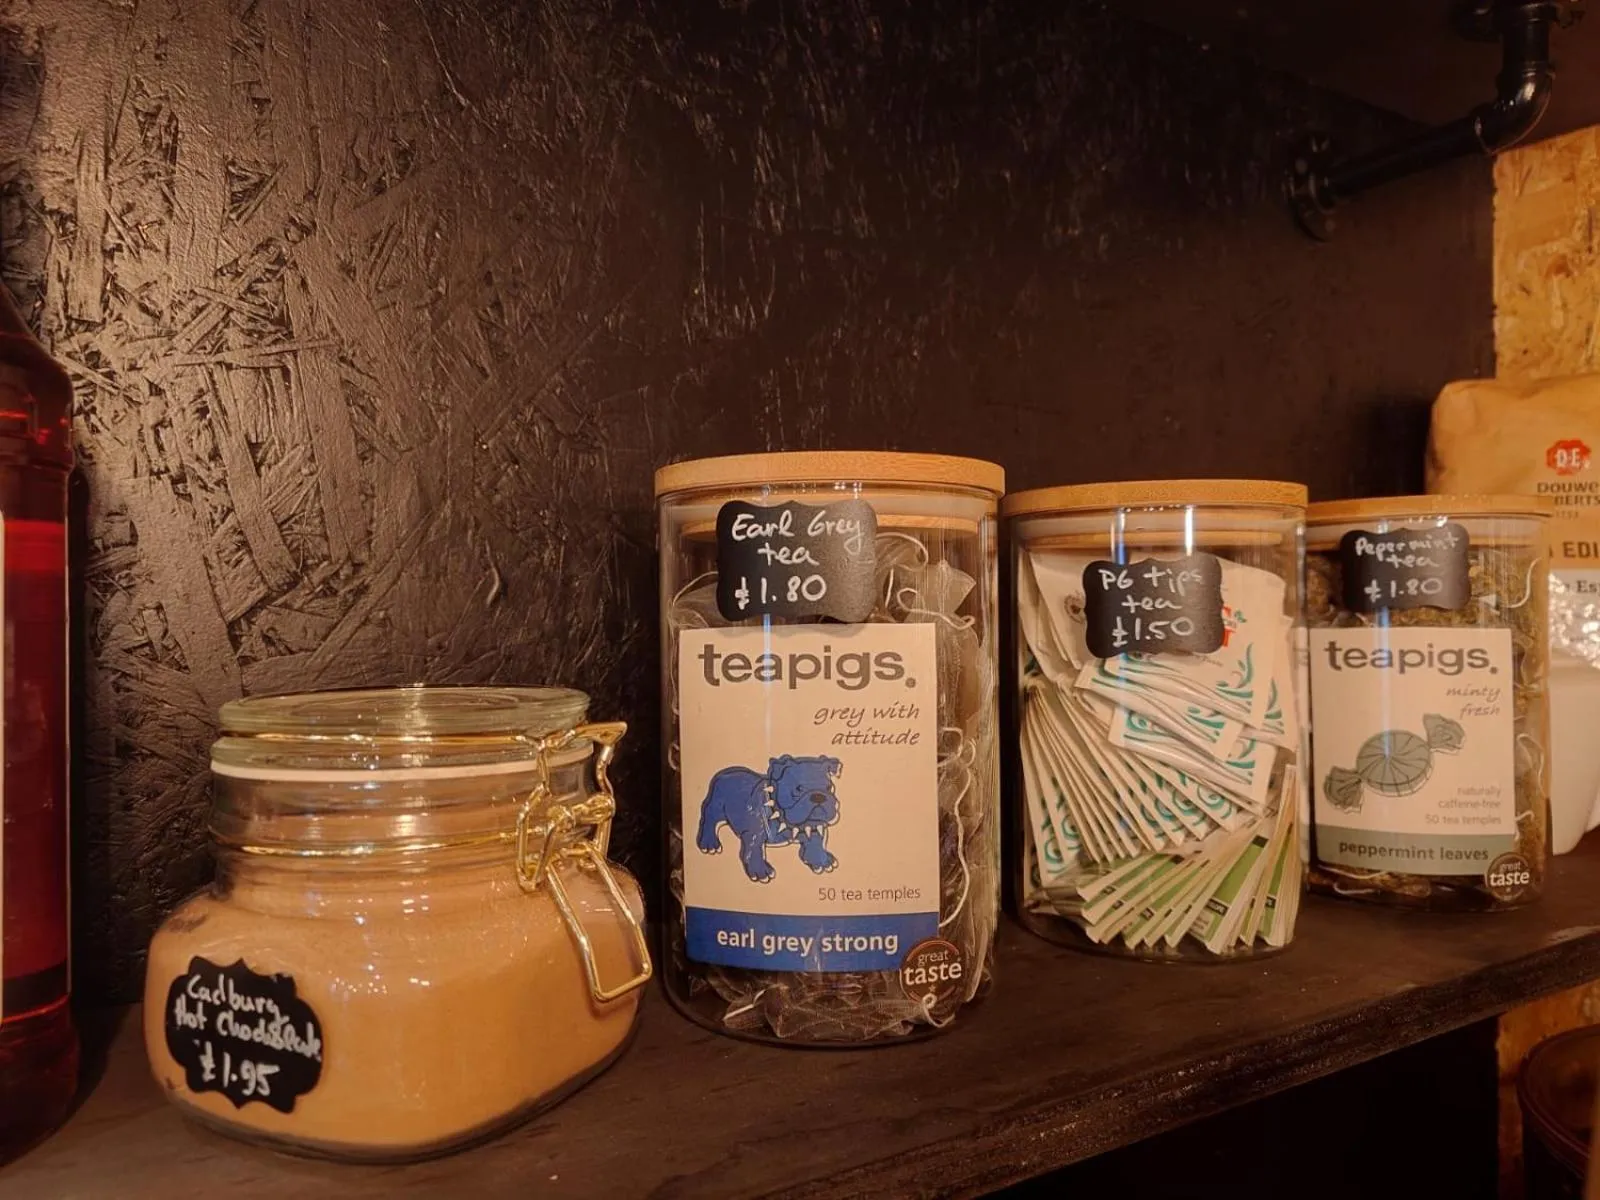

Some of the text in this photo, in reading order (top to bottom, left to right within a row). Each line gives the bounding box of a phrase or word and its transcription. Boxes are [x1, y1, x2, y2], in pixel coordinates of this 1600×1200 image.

[732, 510, 861, 555] Earl Grey
[757, 543, 819, 566] tea
[1386, 554, 1440, 568] tea
[735, 574, 827, 610] £1.80
[1143, 566, 1203, 597] tips
[1364, 577, 1443, 603] £1.80
[1121, 594, 1183, 614] tea
[1112, 616, 1194, 648] £1.50
[1446, 684, 1501, 702] minty
[813, 701, 920, 728] grey with
[1459, 703, 1500, 719] fresh
[831, 727, 921, 746] attitude
[1425, 814, 1502, 826] 50 tea temples
[1339, 840, 1488, 860] peppermint leaves
[1489, 871, 1530, 886] taste
[818, 887, 921, 902] 50 tea temples
[717, 929, 899, 957] earl grey strong
[917, 950, 949, 967] great
[903, 957, 963, 986] taste
[175, 994, 207, 1029] Hot
[187, 974, 290, 1025] Cadbury
[199, 1041, 280, 1096] £1.95
